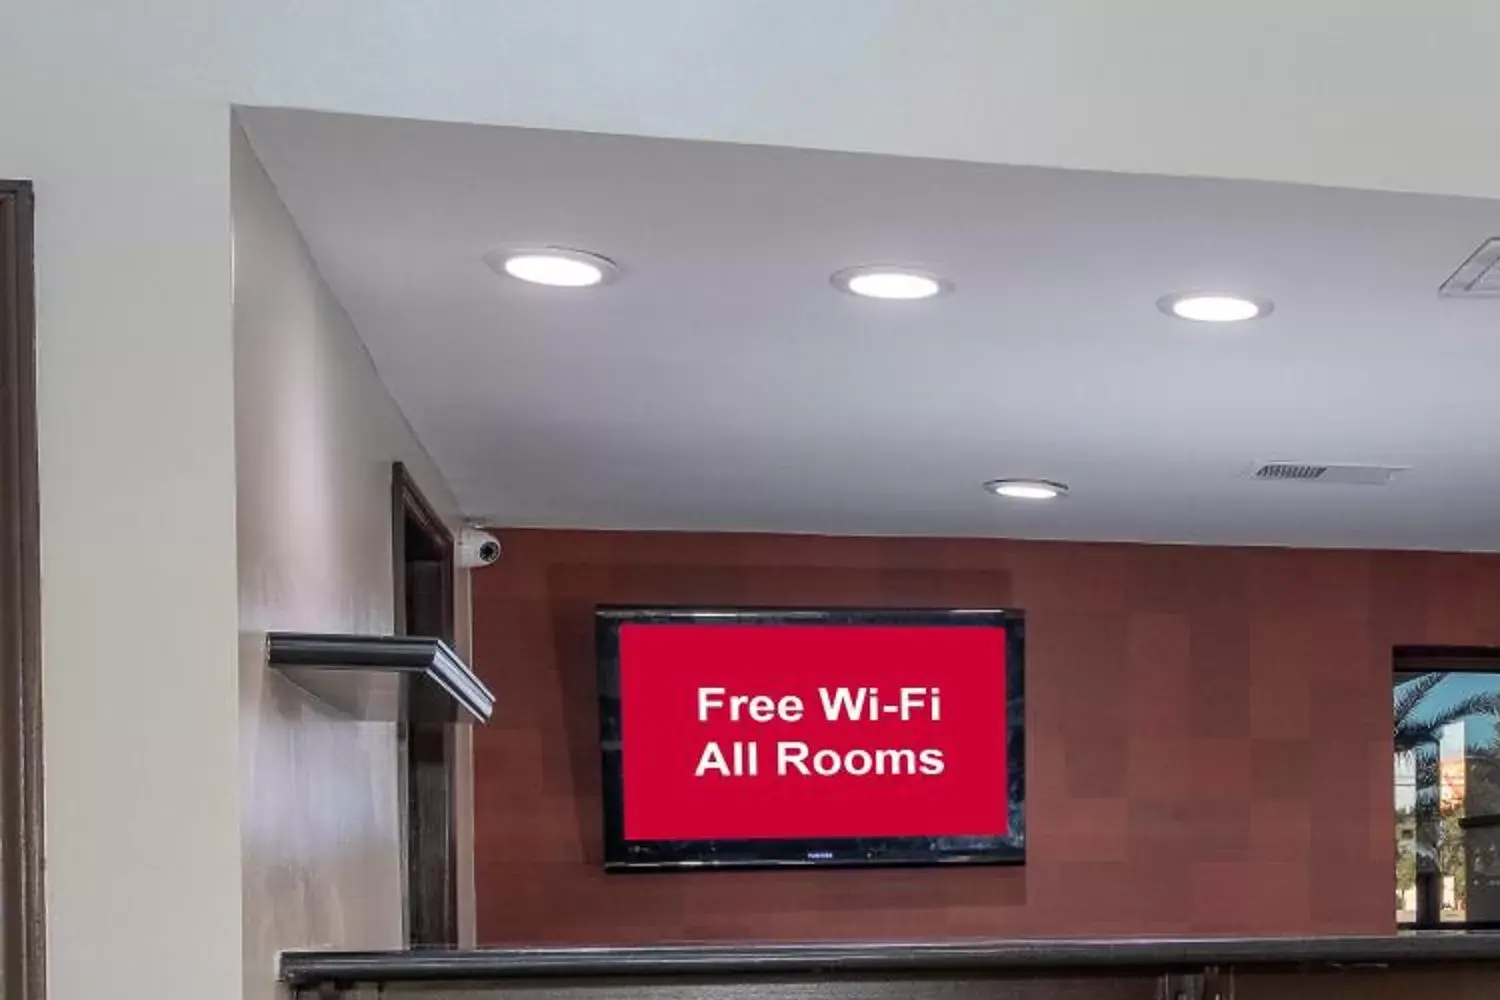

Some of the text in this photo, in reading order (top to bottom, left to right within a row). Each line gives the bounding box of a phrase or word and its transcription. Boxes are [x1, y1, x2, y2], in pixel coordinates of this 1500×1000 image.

[697, 687, 941, 722] Free Wi-Fi
[694, 741, 945, 777] All Rooms
